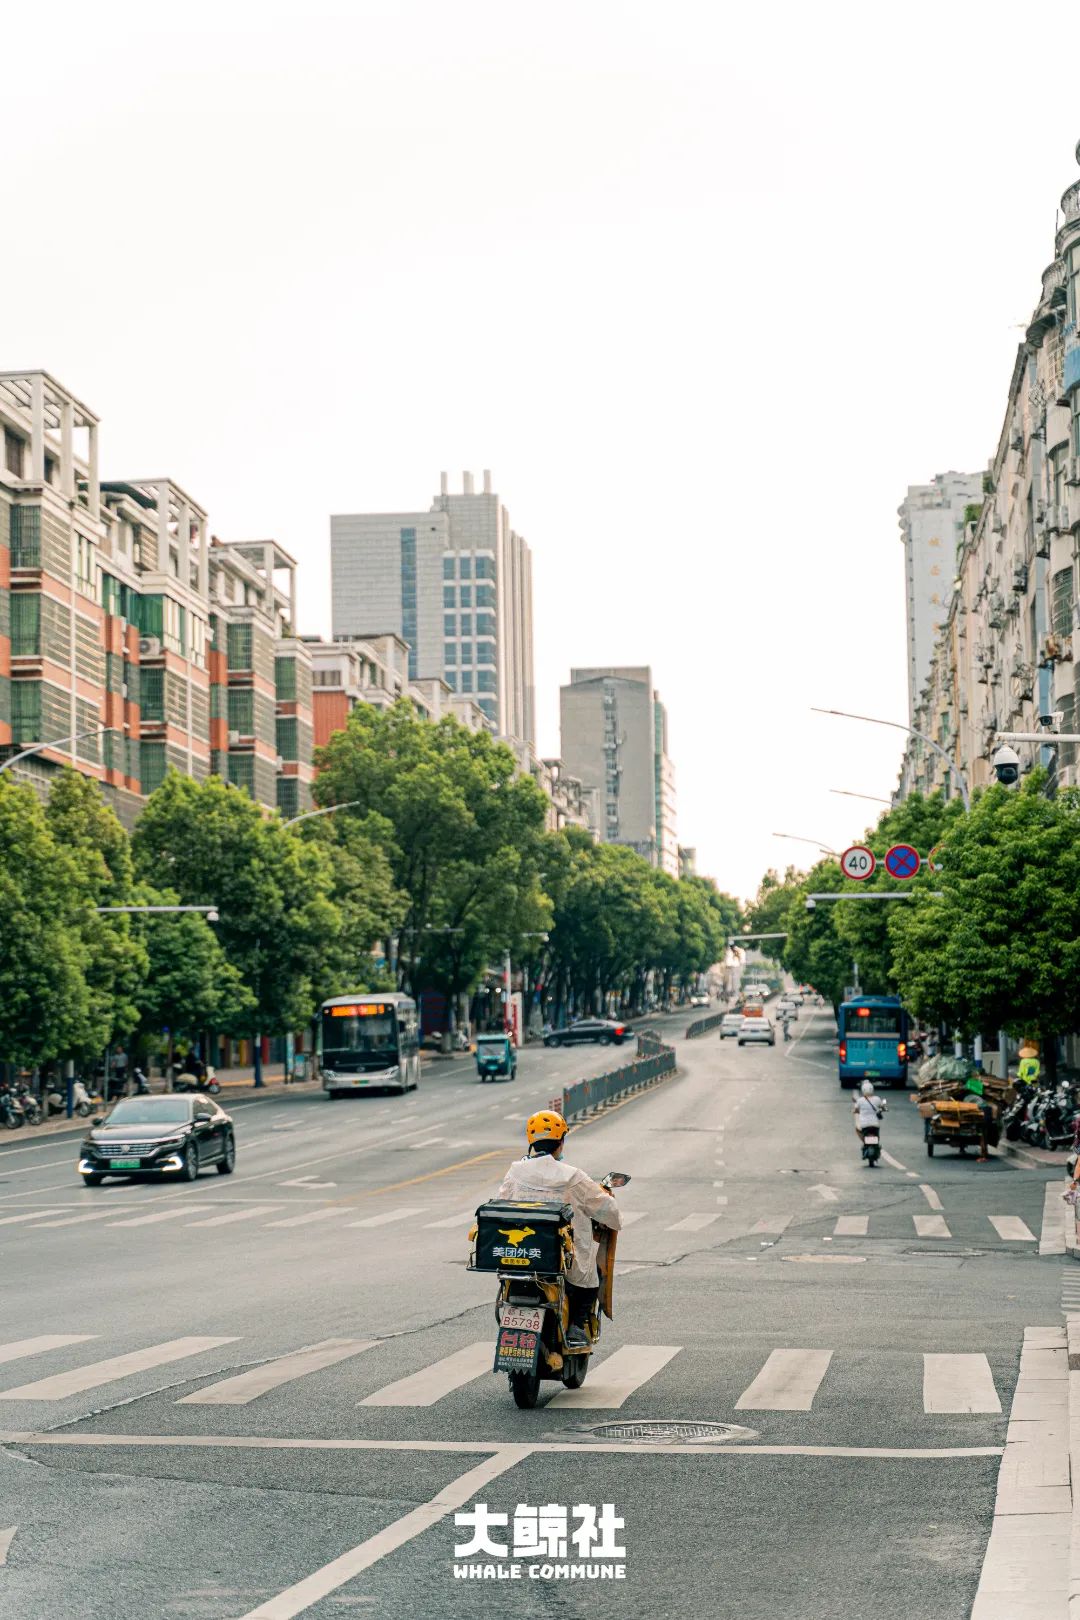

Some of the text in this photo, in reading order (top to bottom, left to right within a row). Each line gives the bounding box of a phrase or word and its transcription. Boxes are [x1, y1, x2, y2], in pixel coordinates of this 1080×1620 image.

[849, 856, 868, 871] 40
[492, 1246, 542, 1259] 美团外卖
[503, 1316, 540, 1331] B5738
